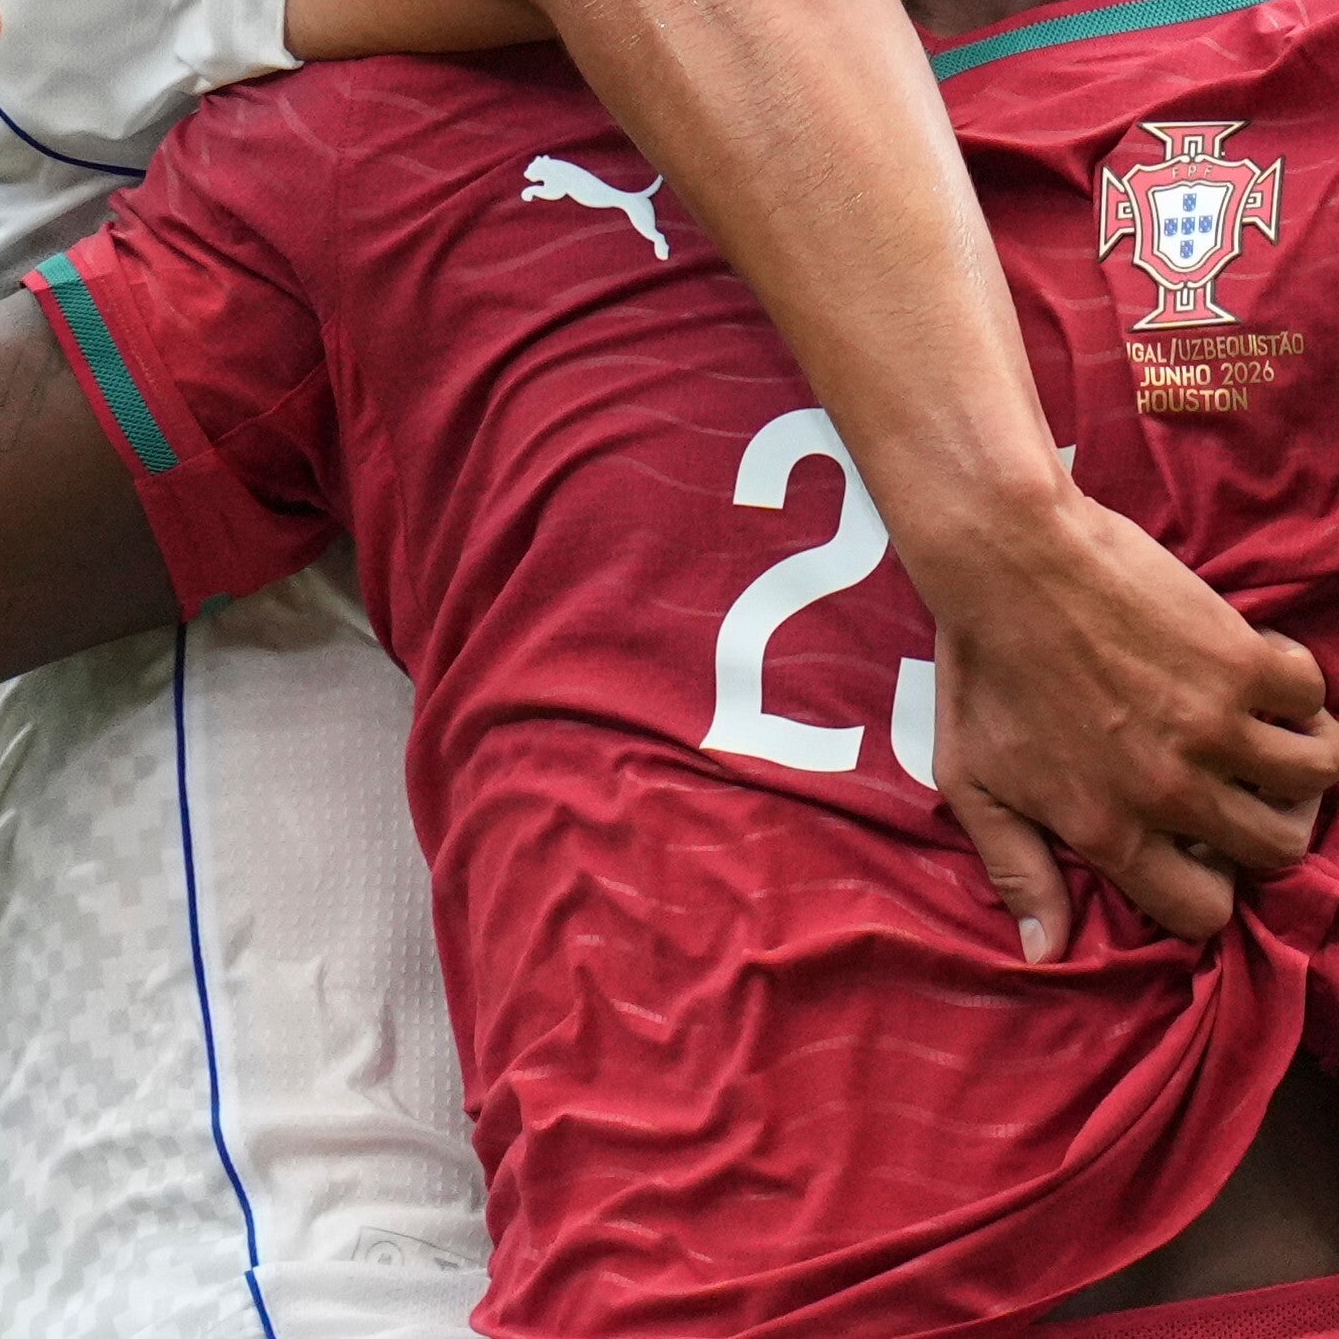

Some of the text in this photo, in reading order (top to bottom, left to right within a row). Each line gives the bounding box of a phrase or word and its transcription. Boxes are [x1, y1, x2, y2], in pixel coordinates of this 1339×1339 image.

[1171, 164, 1214, 179] FPF
[1140, 360, 1275, 387] JUNHO 2026
[1136, 387, 1249, 414] HOUSTON
